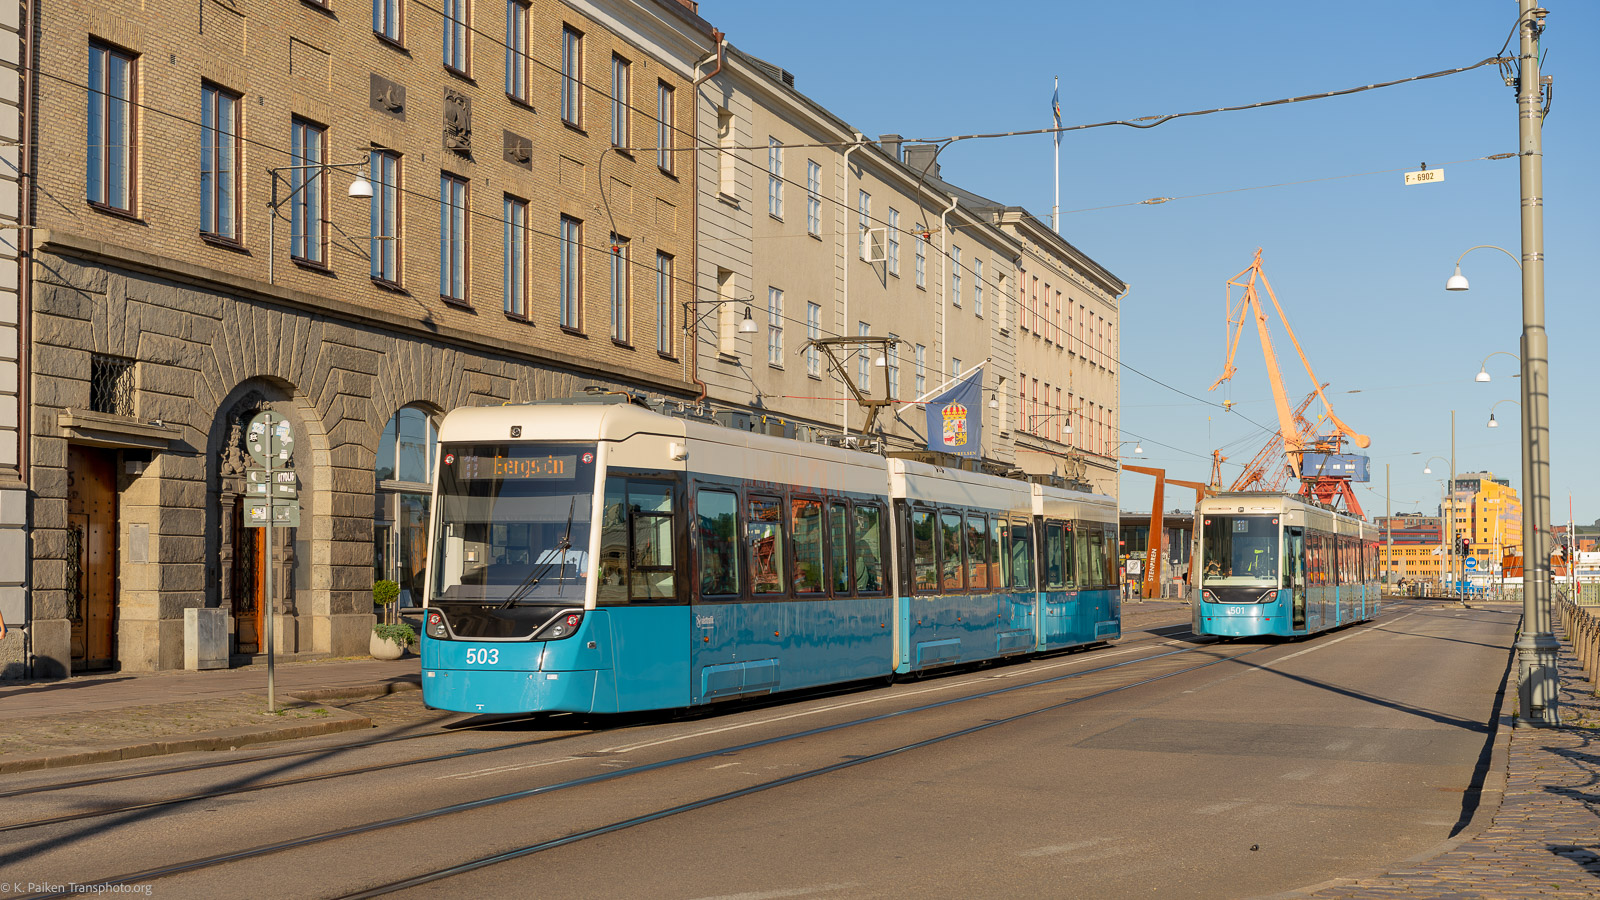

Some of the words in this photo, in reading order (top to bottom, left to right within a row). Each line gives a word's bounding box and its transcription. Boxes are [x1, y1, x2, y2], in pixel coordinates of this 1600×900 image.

[1417, 172, 1435, 182] 6902
[1148, 548, 1157, 582] STENPIREN
[1230, 606, 1245, 615] 501
[466, 648, 499, 665] 503
